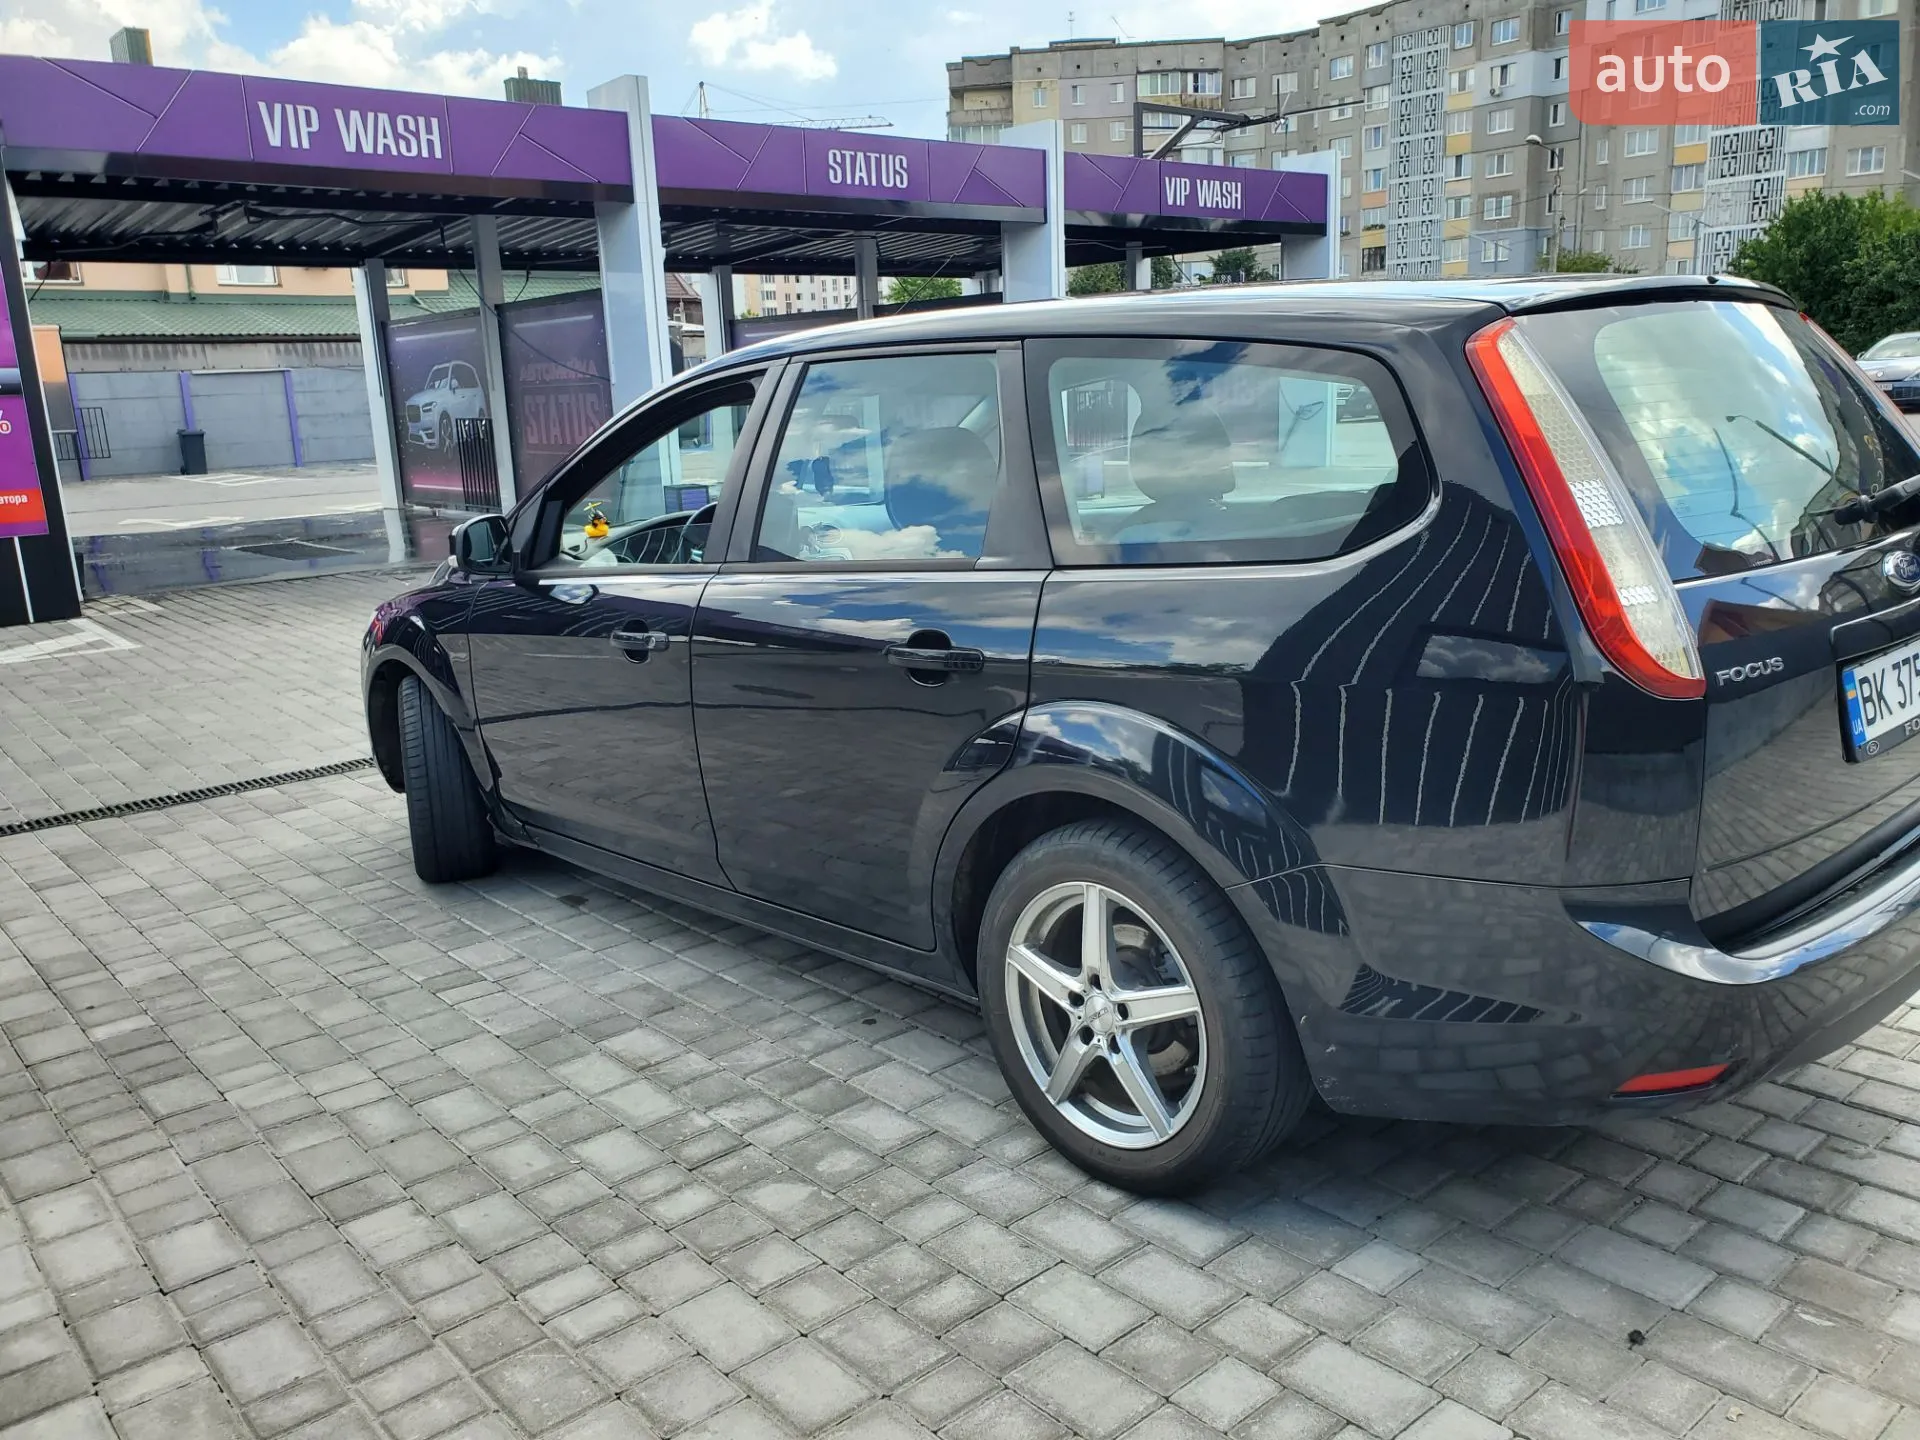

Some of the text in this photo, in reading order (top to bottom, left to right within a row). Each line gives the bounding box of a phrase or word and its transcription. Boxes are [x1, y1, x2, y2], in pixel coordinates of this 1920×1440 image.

[257, 101, 442, 160] VIP WASH
[828, 149, 908, 189] STATUS
[1165, 176, 1243, 211] VIP WASH
[1715, 657, 1784, 686] FOCUS
[1859, 668, 1893, 727] BK
[1852, 720, 1864, 735] UA
